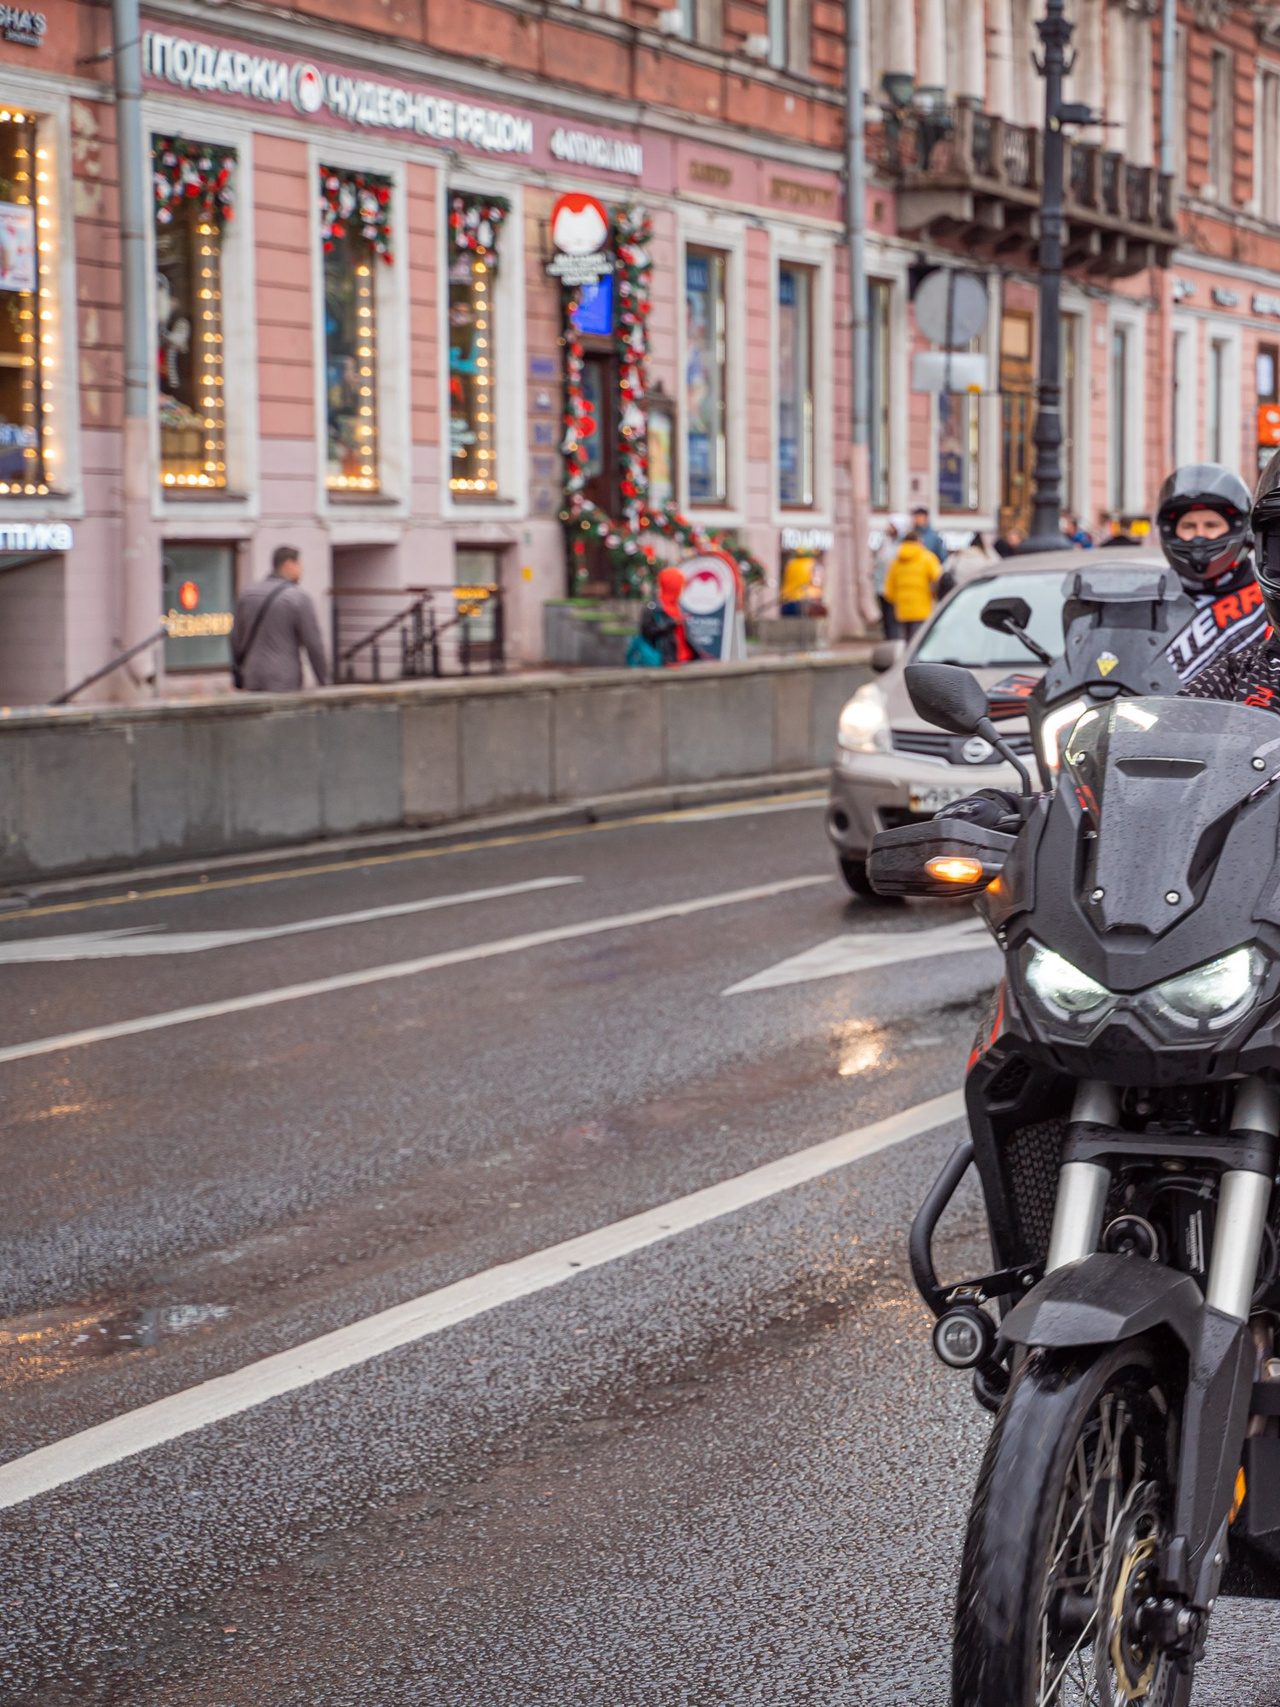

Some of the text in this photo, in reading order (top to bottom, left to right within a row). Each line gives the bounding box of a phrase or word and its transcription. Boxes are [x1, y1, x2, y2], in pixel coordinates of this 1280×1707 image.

[142, 30, 534, 154] ПОДАРКИ ЧУДЕСНОЕ РЯДОМ
